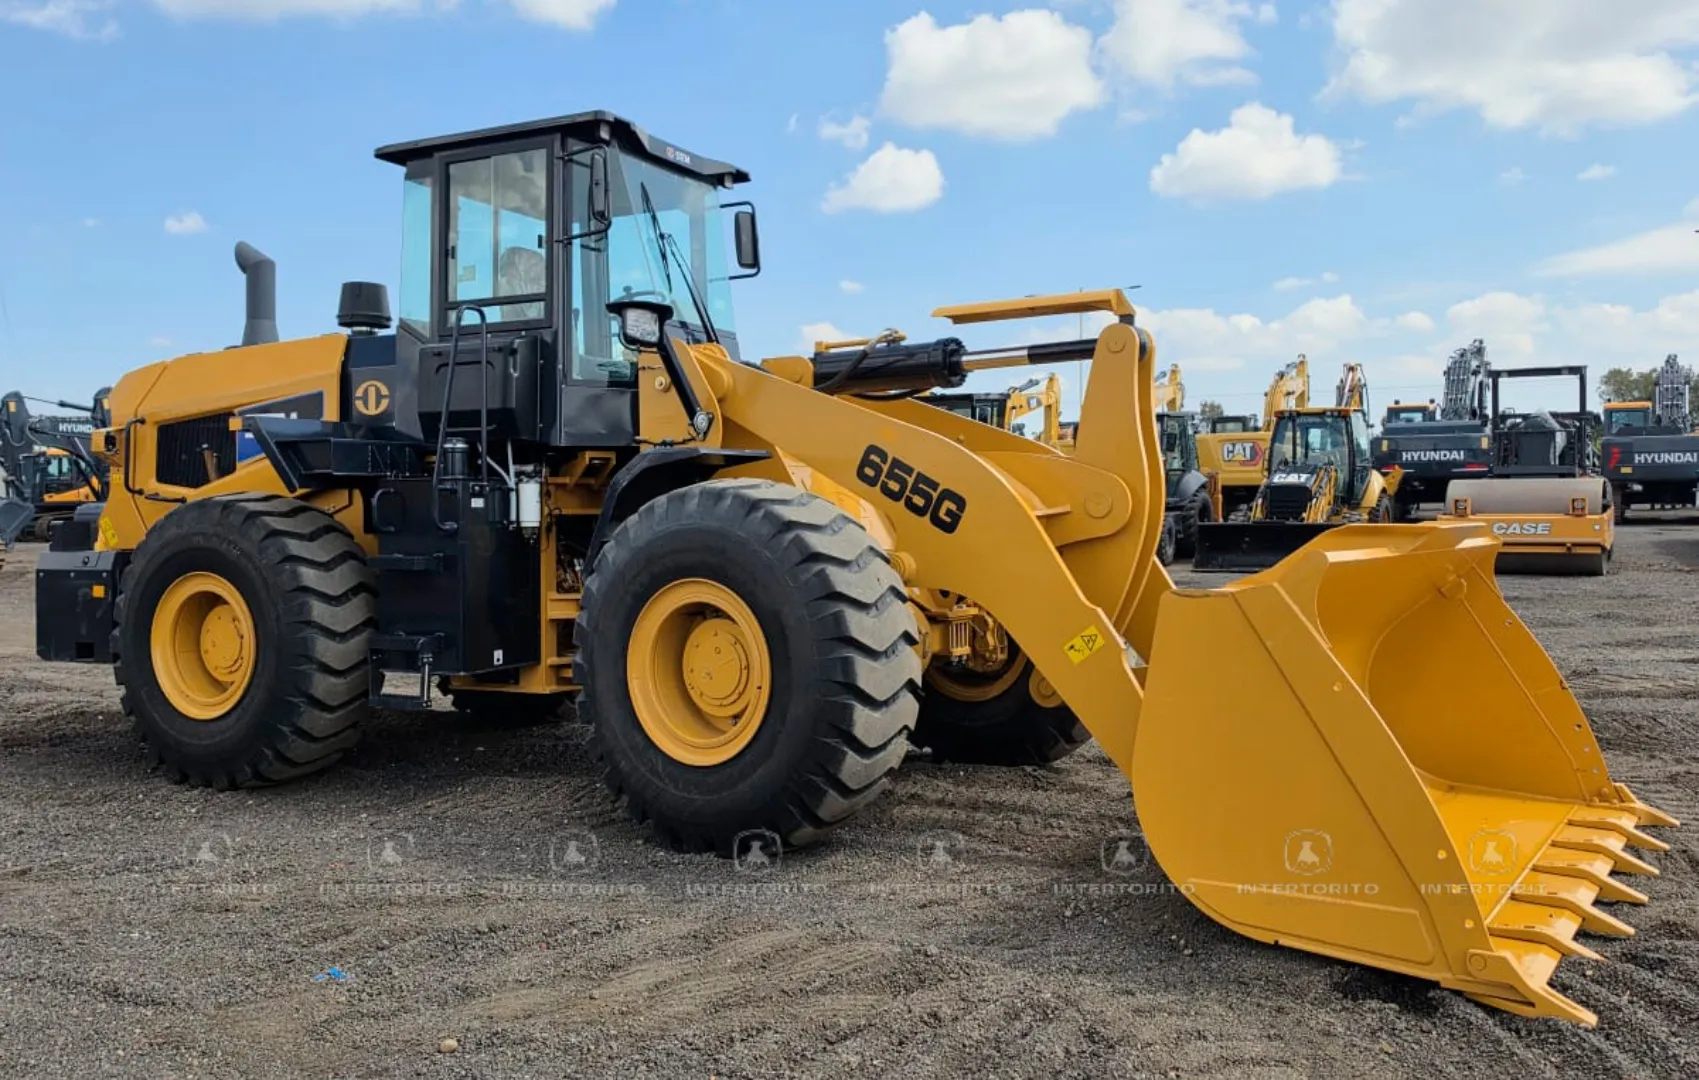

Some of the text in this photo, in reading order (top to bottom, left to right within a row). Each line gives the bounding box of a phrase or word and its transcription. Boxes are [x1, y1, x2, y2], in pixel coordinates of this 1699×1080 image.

[58, 422, 93, 434] HYUND
[1222, 442, 1254, 461] CAT
[1402, 450, 1465, 461] HYUNDAI
[1634, 452, 1698, 464] HYUNDAI
[1272, 473, 1312, 484] CAT
[856, 444, 967, 534] 655G
[1492, 522, 1551, 535] CASE
